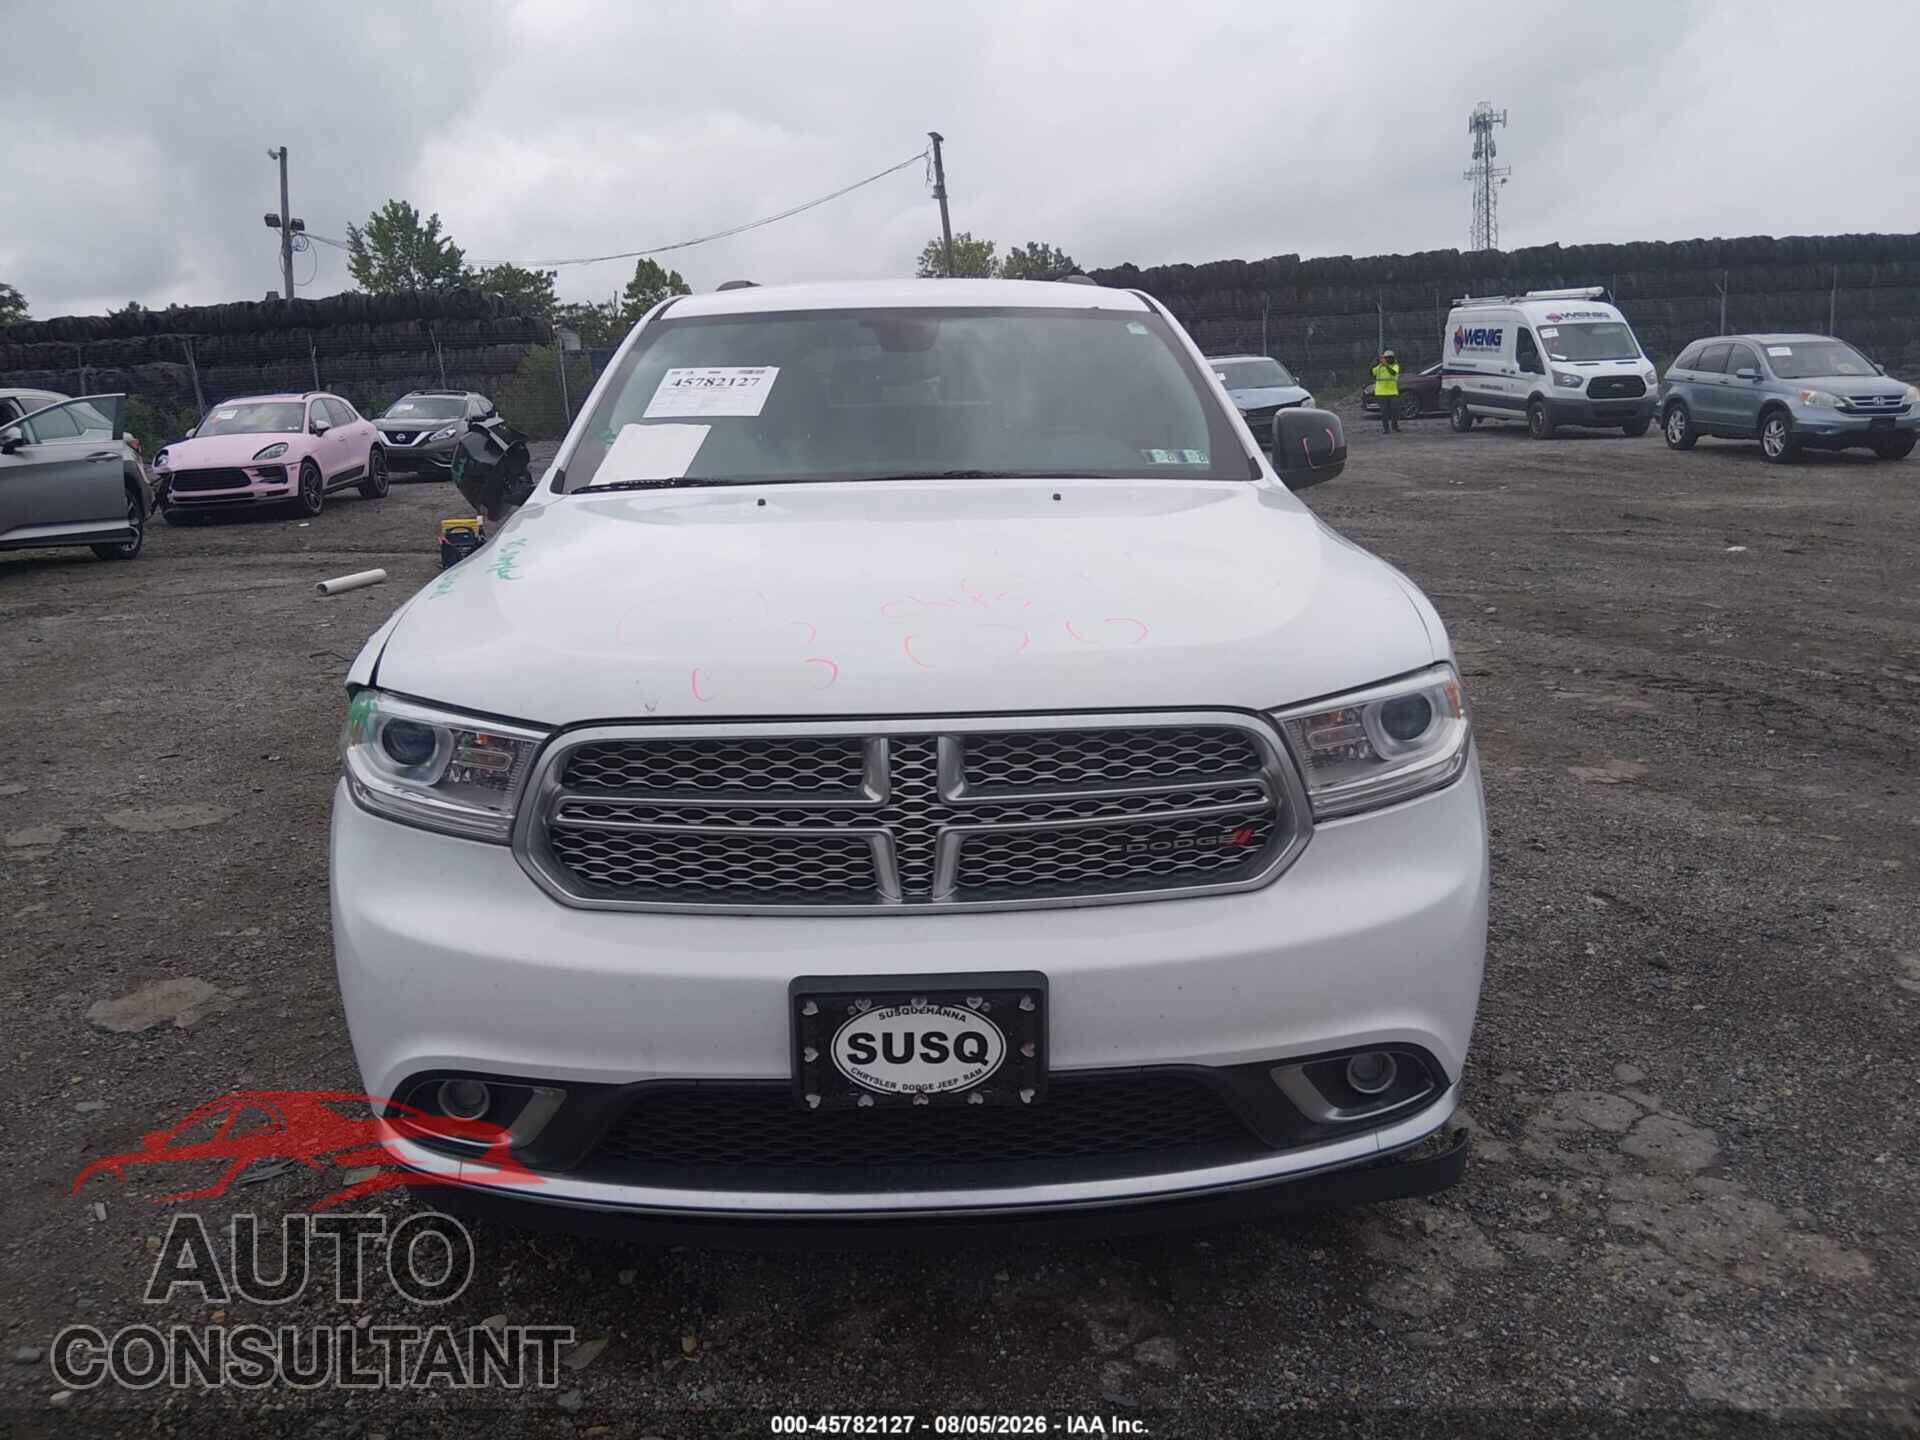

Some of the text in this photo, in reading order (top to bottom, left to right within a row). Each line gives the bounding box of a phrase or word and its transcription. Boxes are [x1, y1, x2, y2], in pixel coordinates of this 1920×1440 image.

[1464, 328, 1503, 346] WENIG
[672, 377, 760, 387] 45782127
[1126, 834, 1236, 852] DODGE
[878, 1006, 966, 1022] SUSQUEHANNA
[847, 1031, 989, 1066] SUSQ
[850, 1067, 983, 1091] CHRYSLER DODGE JEEP RAM
